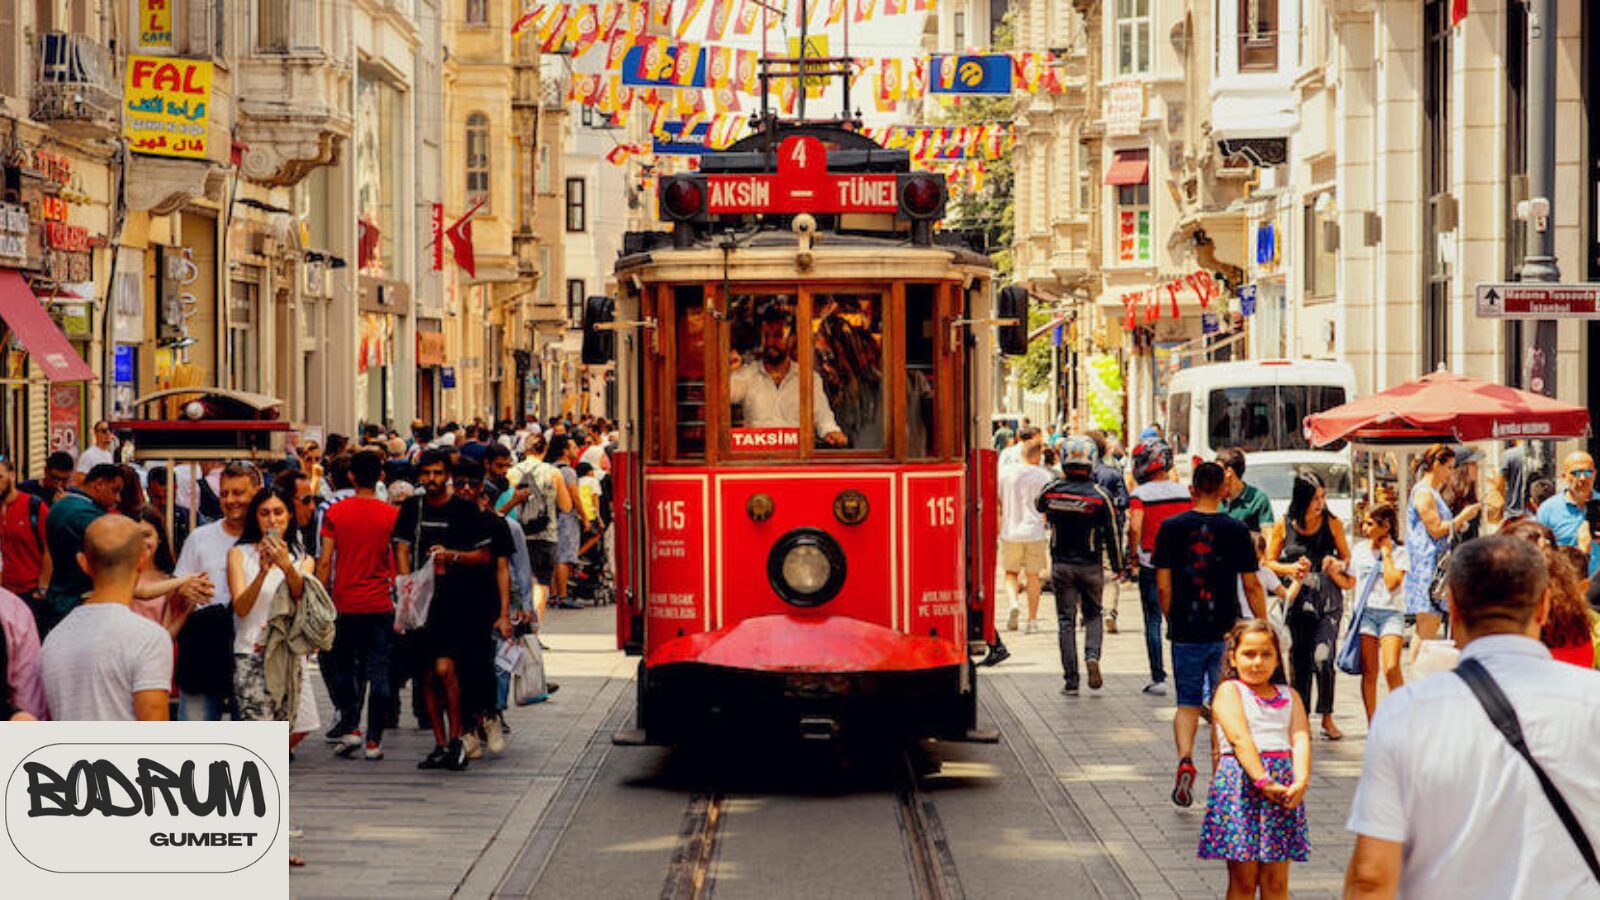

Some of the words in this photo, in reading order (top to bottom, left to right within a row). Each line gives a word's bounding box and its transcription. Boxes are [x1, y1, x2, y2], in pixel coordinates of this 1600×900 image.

[132, 60, 205, 94] FAL
[791, 139, 806, 168] 4
[708, 177, 769, 207] AKSİM
[837, 177, 898, 207] TÜNEL
[52, 430, 74, 447] 50
[732, 430, 799, 446] TAKSİM
[657, 500, 685, 530] 115
[926, 496, 955, 527] 115
